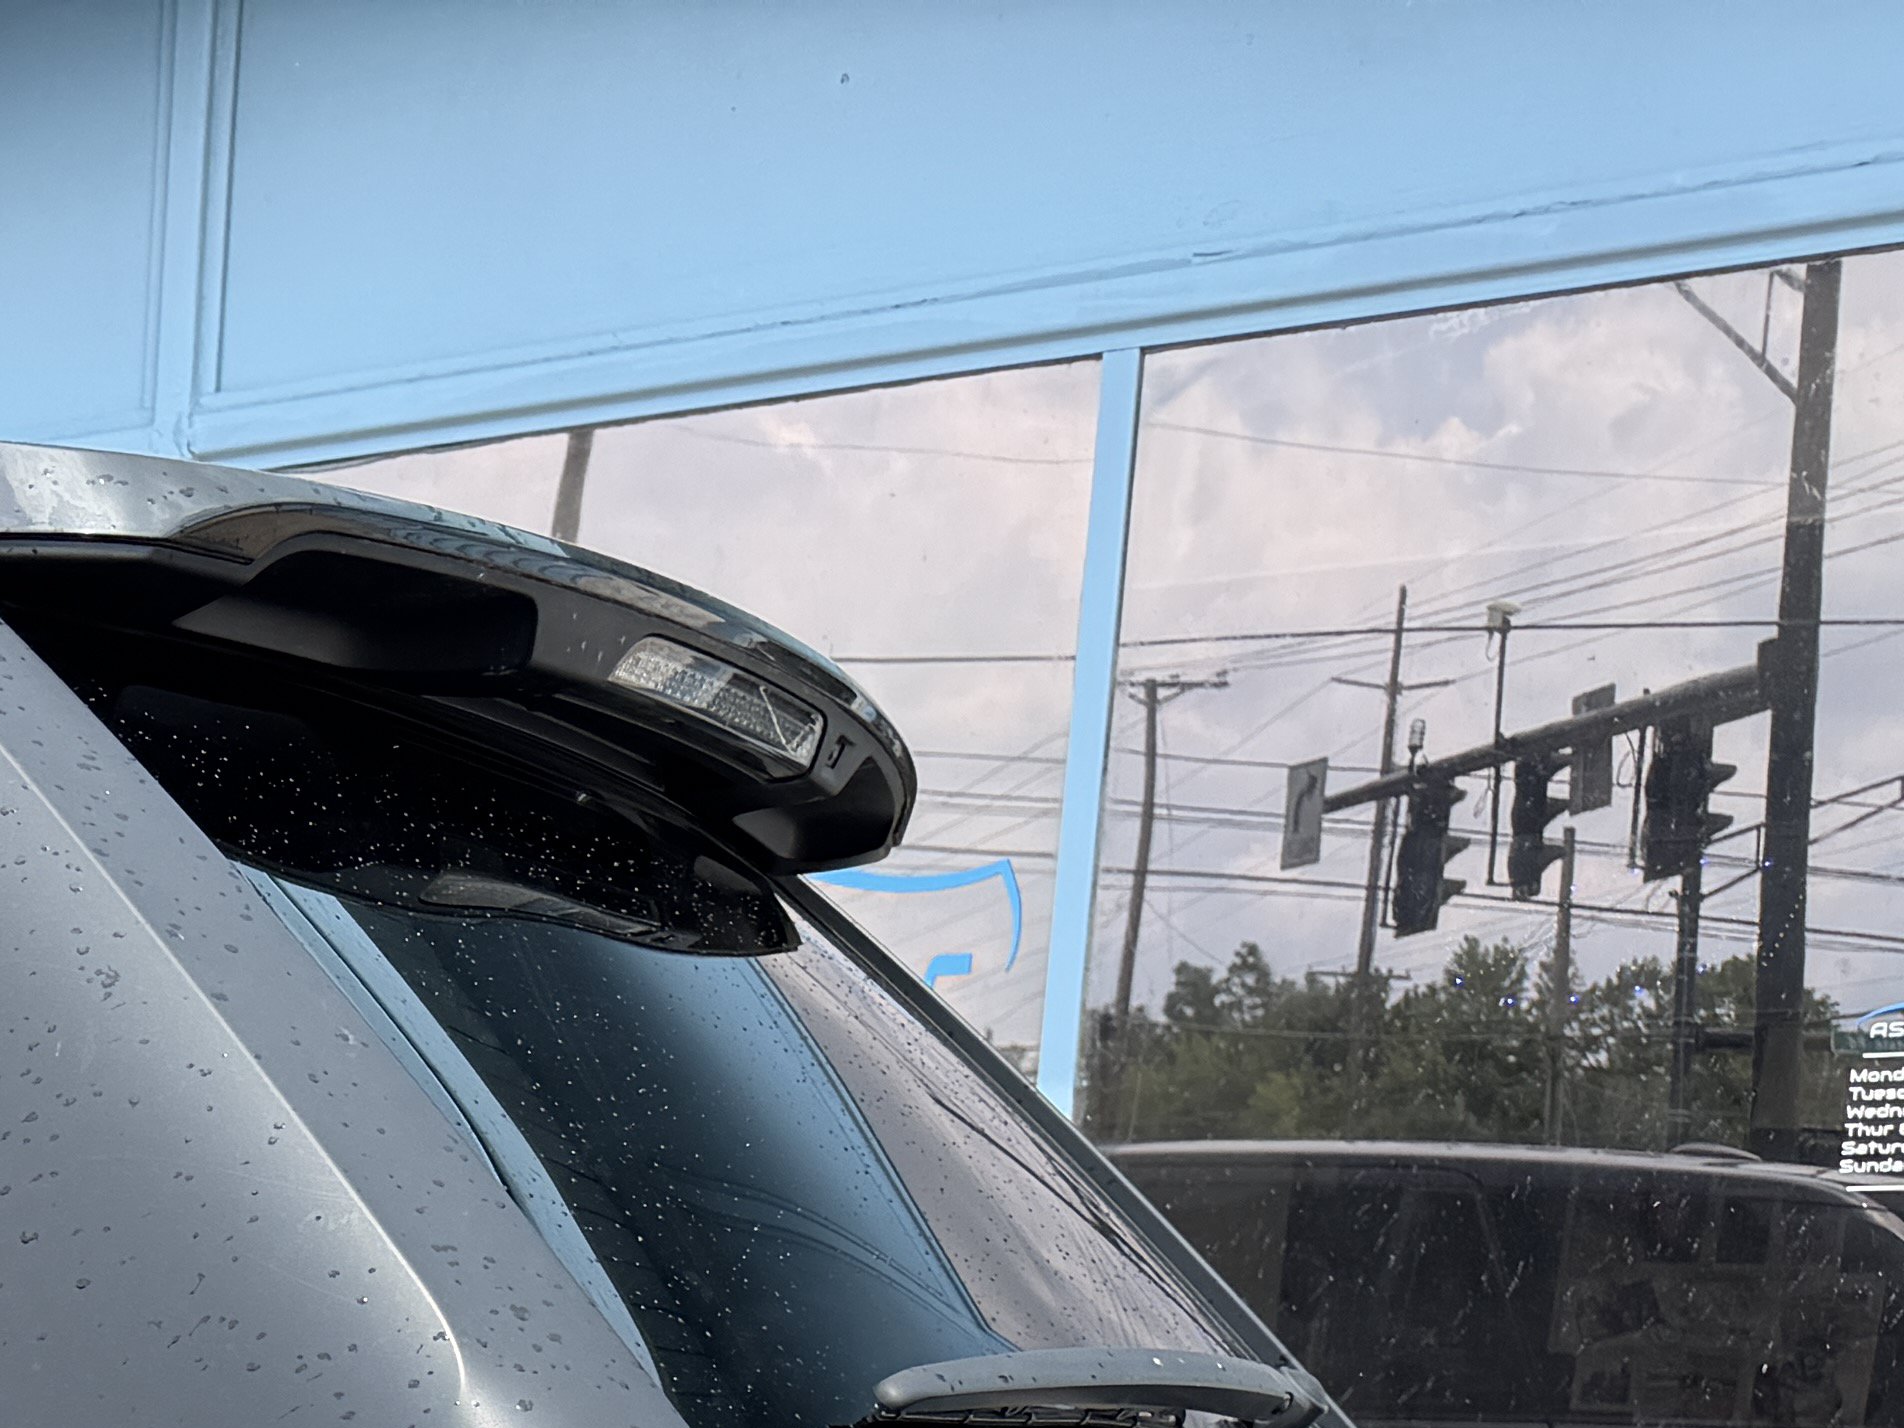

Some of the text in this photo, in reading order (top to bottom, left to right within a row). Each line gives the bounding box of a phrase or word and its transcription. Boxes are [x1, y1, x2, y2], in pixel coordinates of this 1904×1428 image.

[1846, 1103, 1904, 1120] Wedn
[1844, 1121, 1895, 1138] Thur
[1841, 1140, 1904, 1156] Satur
